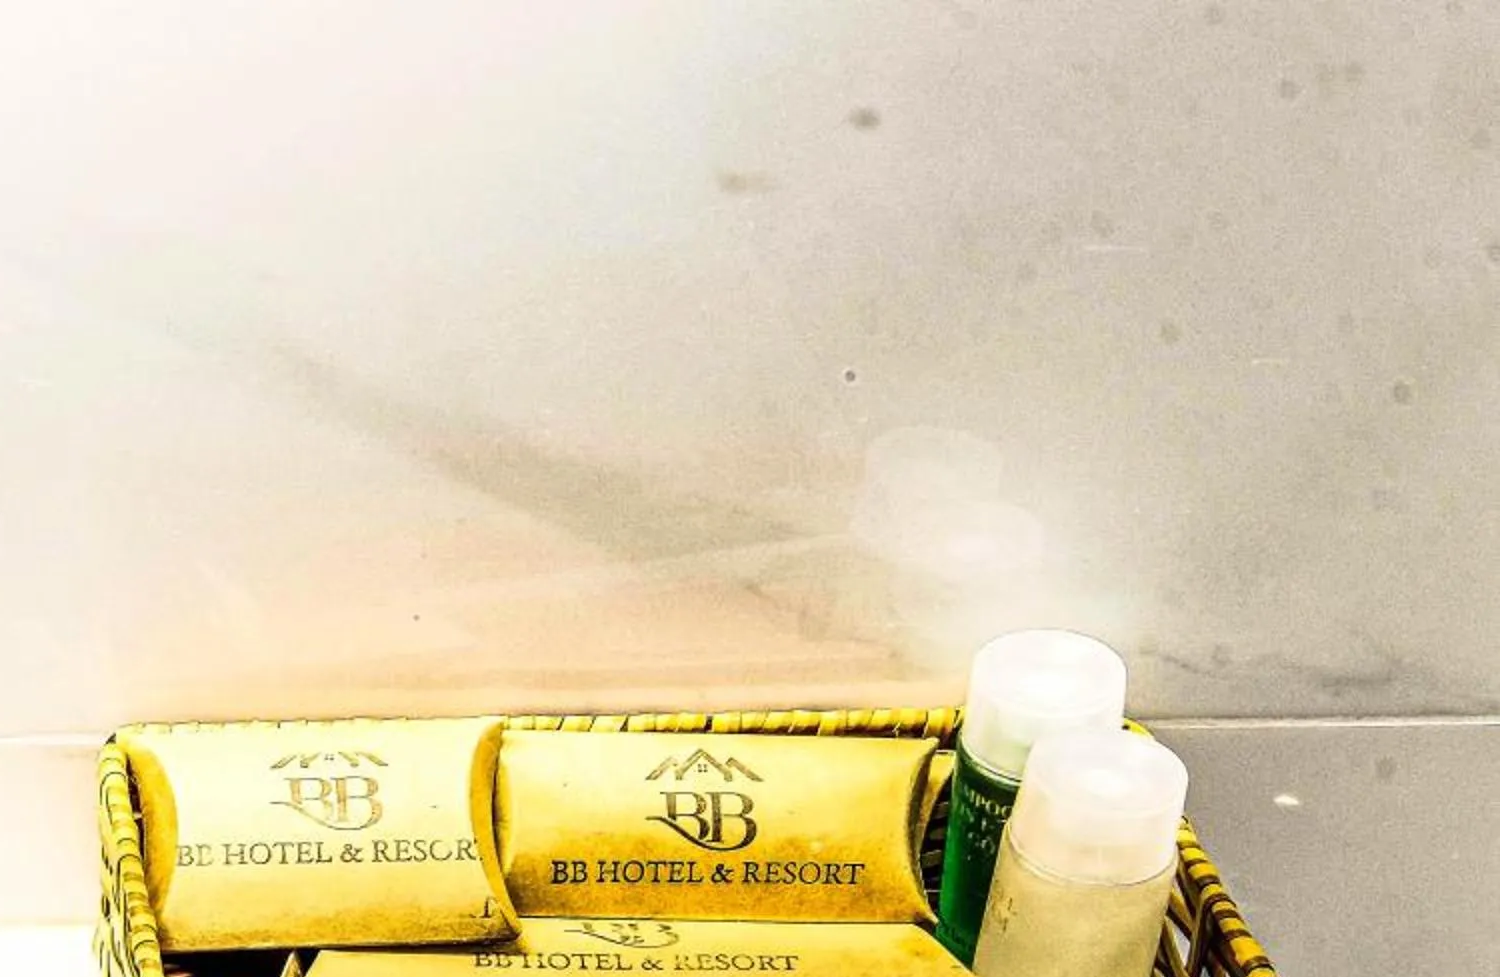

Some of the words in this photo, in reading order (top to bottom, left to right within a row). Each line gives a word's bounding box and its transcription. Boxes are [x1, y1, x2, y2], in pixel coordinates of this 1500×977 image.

[645, 791, 758, 851] BB
[222, 842, 332, 866] HOTEL
[340, 843, 363, 863] &
[371, 839, 483, 862] RESOR
[551, 860, 588, 884] BB
[596, 861, 703, 884] HOTEL
[711, 863, 734, 884] &
[742, 861, 865, 885] RESORT
[521, 953, 632, 971] HOTEL
[641, 958, 664, 970] &
[674, 954, 798, 971] RESORT
